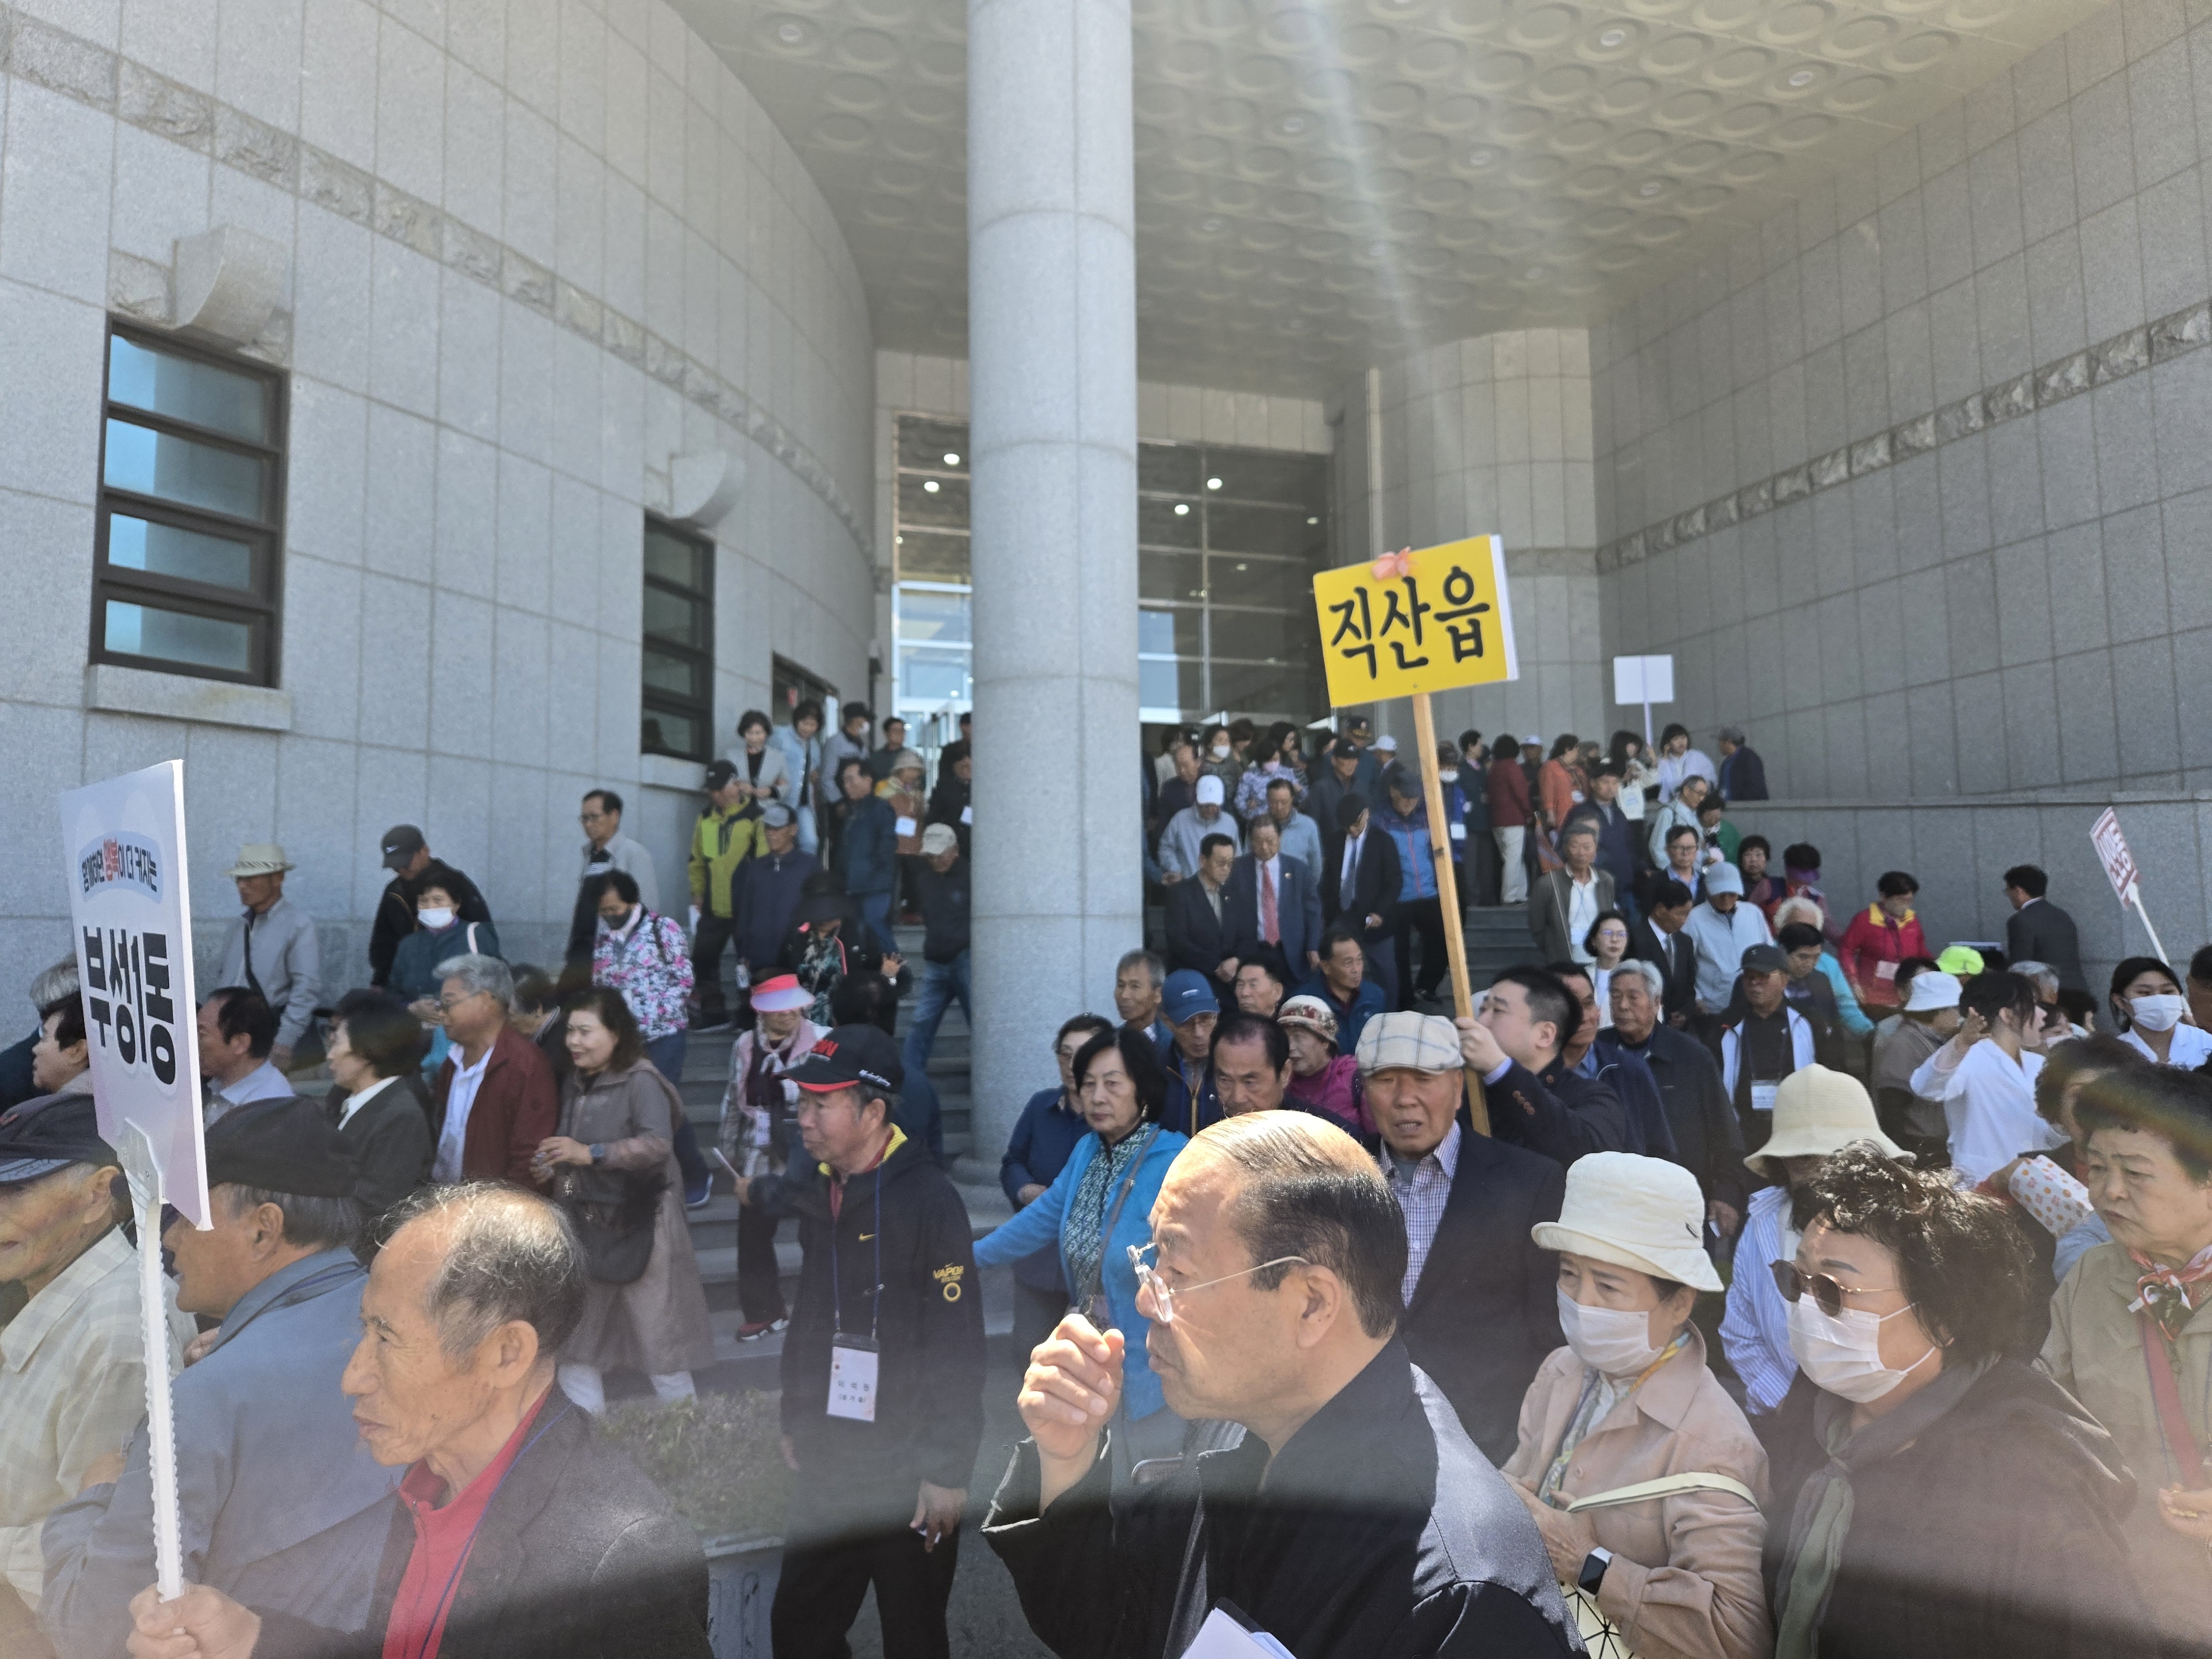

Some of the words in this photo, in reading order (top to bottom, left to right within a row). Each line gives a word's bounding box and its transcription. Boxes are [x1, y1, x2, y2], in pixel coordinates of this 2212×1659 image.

[1328, 566, 1490, 680] 직산읍
[81, 848, 105, 893] 함께하면
[103, 837, 126, 881] 행복이
[126, 845, 134, 880] 더
[134, 847, 157, 893] 커지는
[82, 926, 176, 1085] 부성1동
[933, 1265, 964, 1279] VAPOR
